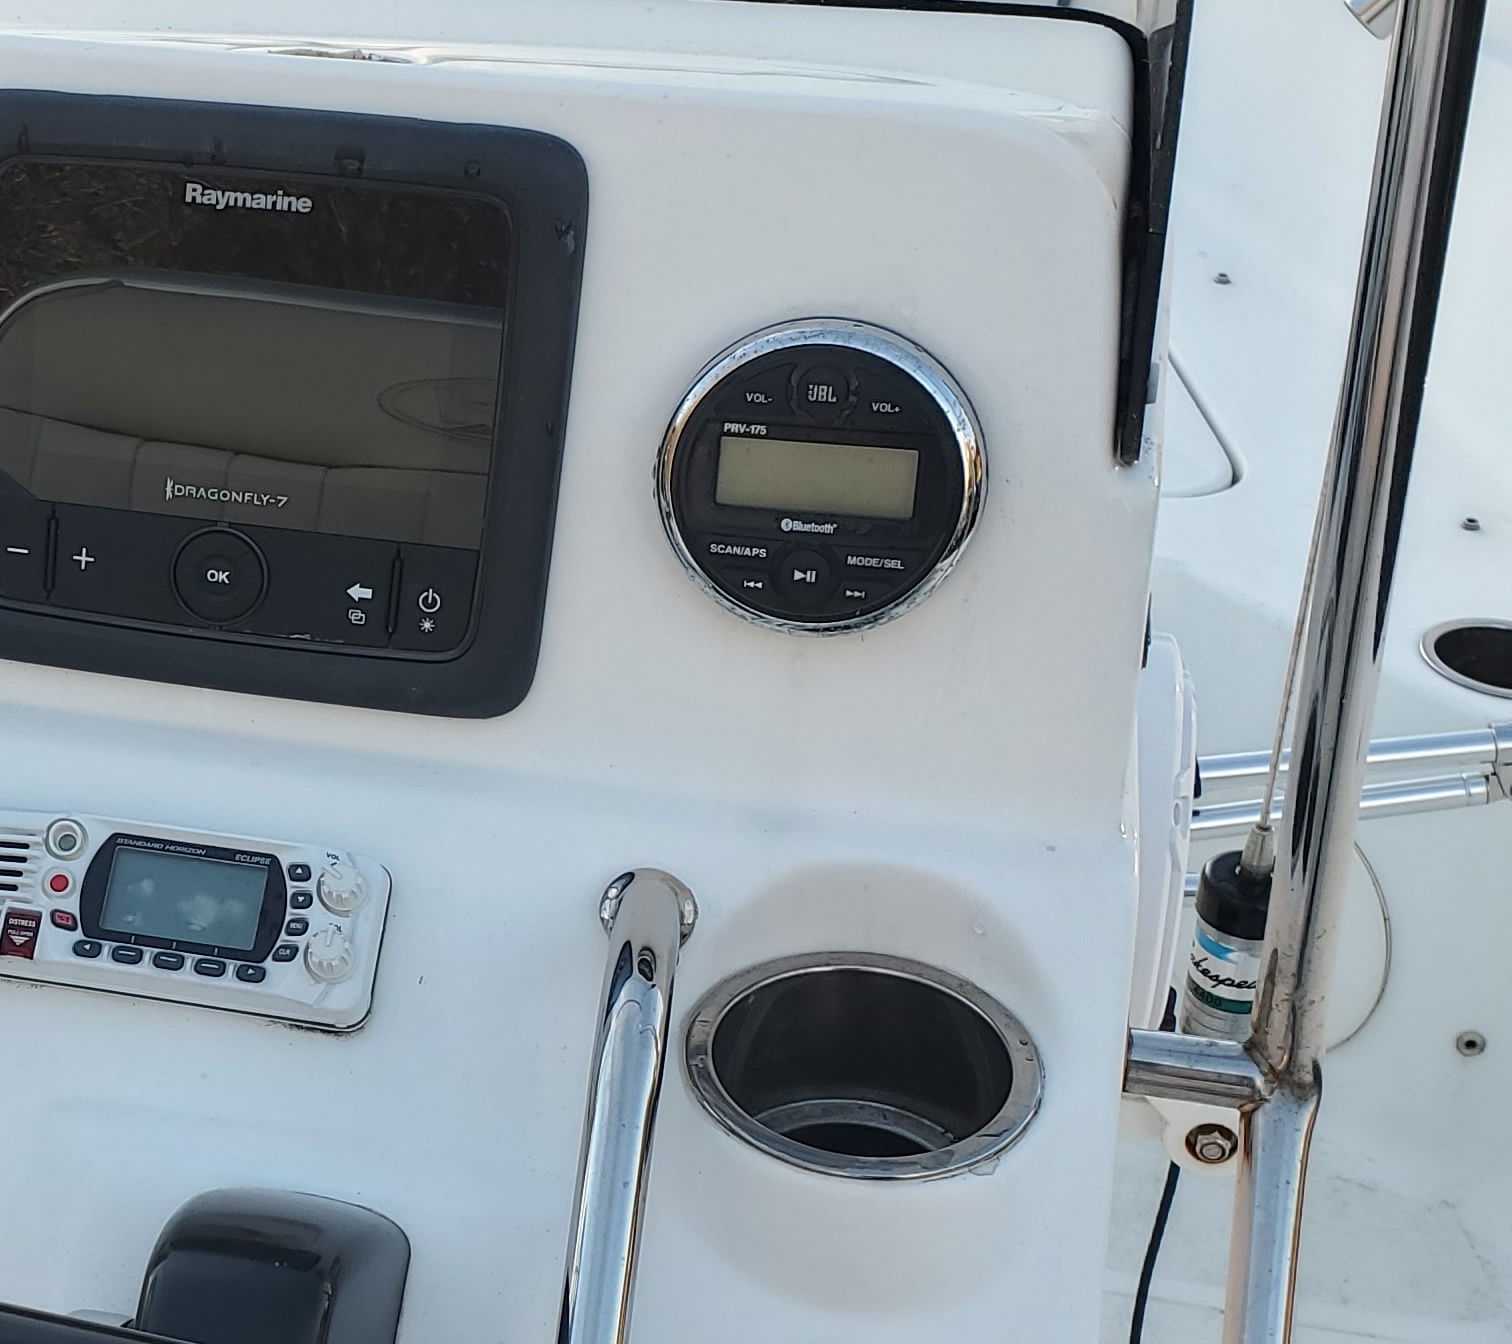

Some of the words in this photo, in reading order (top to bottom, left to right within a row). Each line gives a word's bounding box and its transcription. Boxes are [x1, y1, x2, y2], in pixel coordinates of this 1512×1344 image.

[185, 182, 312, 213] Raymarine
[746, 392, 773, 404] VOL-
[808, 384, 837, 403] JBL
[872, 402, 901, 413] VOL+
[724, 423, 767, 435] PRV-175
[174, 484, 288, 508] DRAGONFLY-7
[792, 520, 835, 534] Bluetooth
[710, 543, 767, 557] SCAN/APS
[847, 555, 904, 570] MODE/SEL
[207, 570, 230, 584] OK
[165, 843, 207, 856] HORIZON
[235, 854, 272, 865] ECLIPSE
[8, 917, 36, 928] DISTRESS
